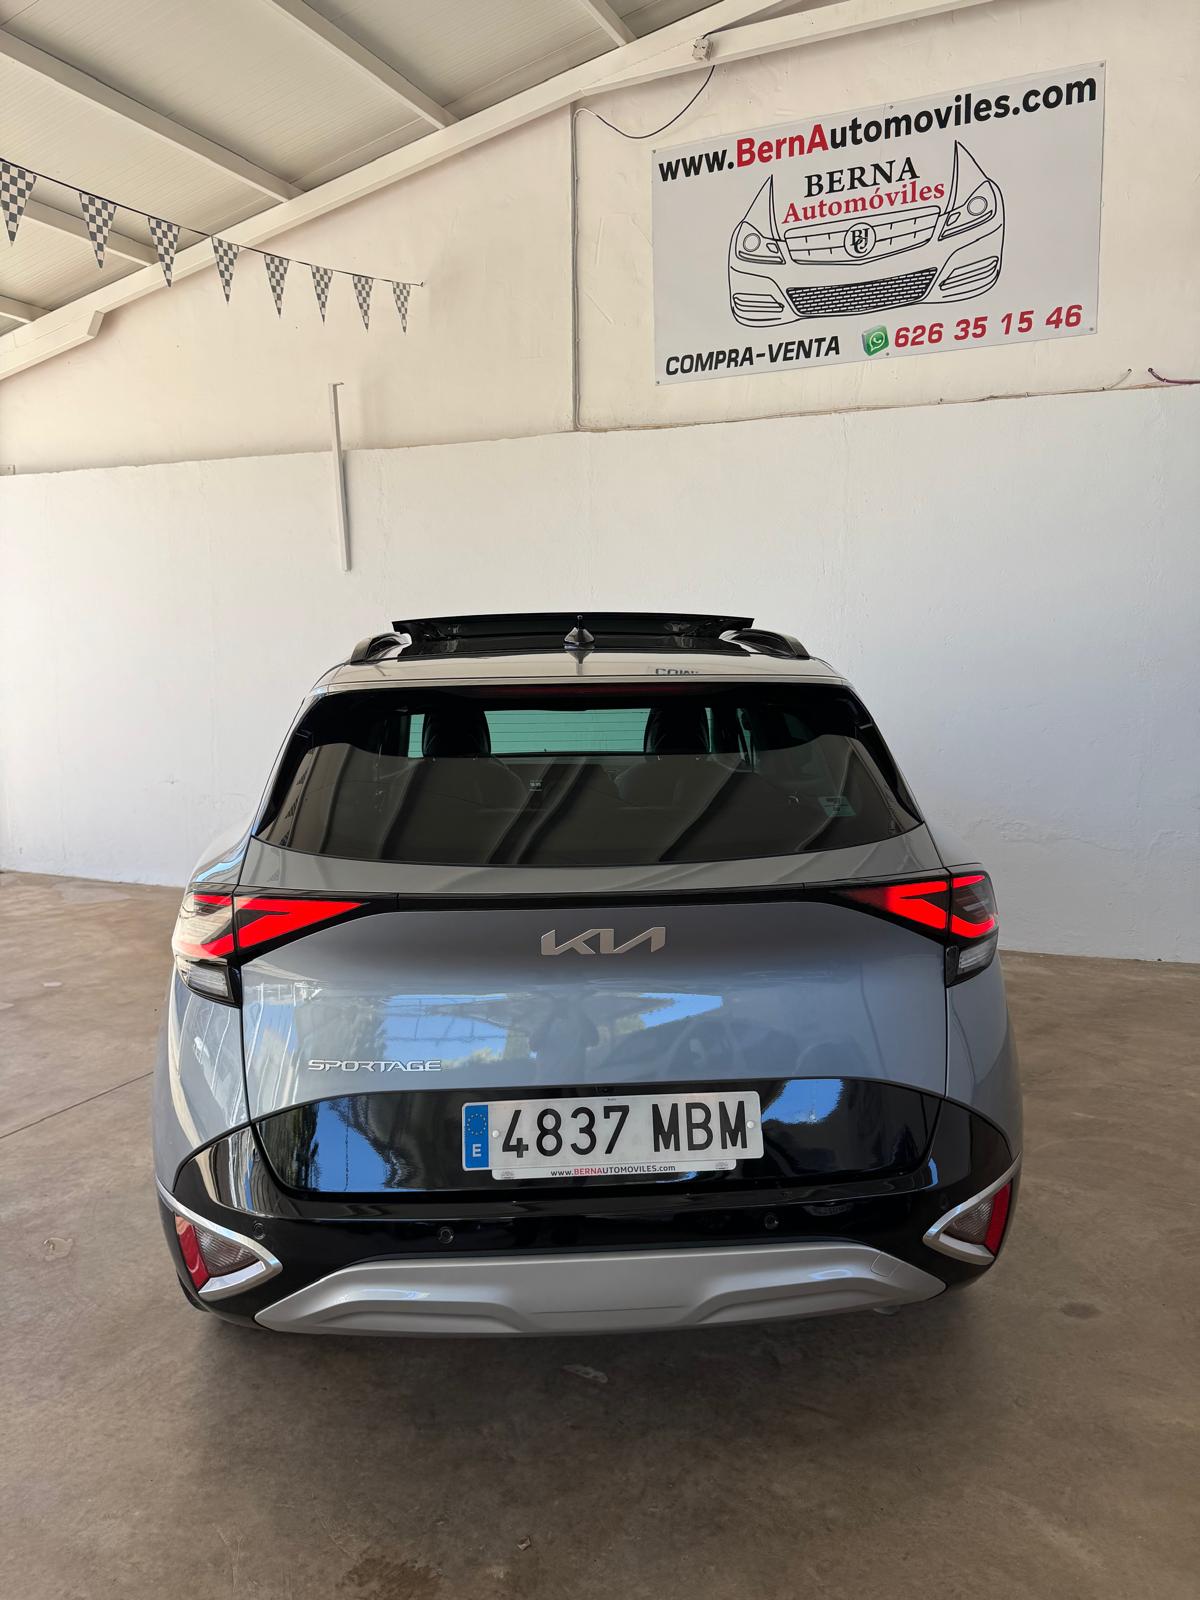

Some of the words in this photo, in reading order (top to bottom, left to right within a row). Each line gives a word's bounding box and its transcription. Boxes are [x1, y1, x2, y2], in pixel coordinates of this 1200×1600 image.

[659, 77, 1097, 182] www.BernAutomoviles.com
[804, 156, 920, 198] BERNA
[781, 181, 946, 224] Automóviles
[894, 321, 944, 348] 626
[953, 316, 988, 341] 35
[1000, 310, 1034, 336] 15
[1045, 304, 1083, 330] 46
[665, 335, 841, 376] COMPRA-VENTA
[541, 926, 666, 956] KIA
[307, 1058, 442, 1073] SPORTAGE
[501, 1104, 630, 1158] 4837
[651, 1100, 748, 1152] MBM
[471, 1143, 483, 1158] E
[550, 1164, 676, 1177] www.BERNAUTOMOVILES.com
